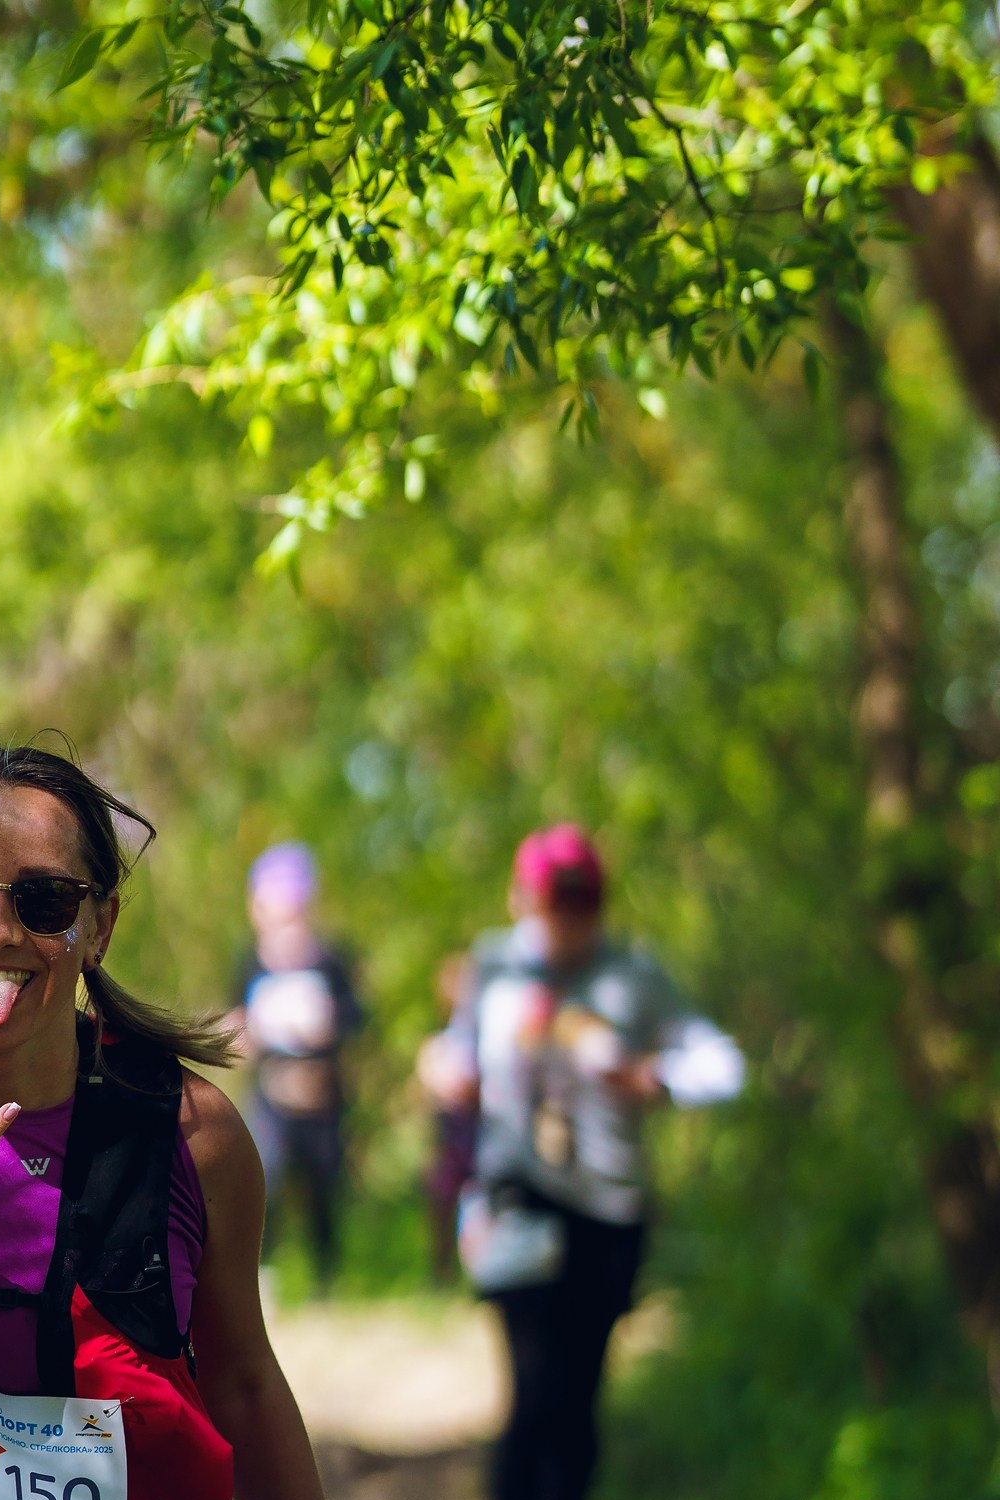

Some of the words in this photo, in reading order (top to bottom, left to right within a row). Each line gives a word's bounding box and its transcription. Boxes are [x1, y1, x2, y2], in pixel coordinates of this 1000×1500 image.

[40, 1424, 64, 1437] 40
[29, 1443, 93, 1454] СТРЕЛКОВКА»
[93, 1446, 114, 1454] 2025
